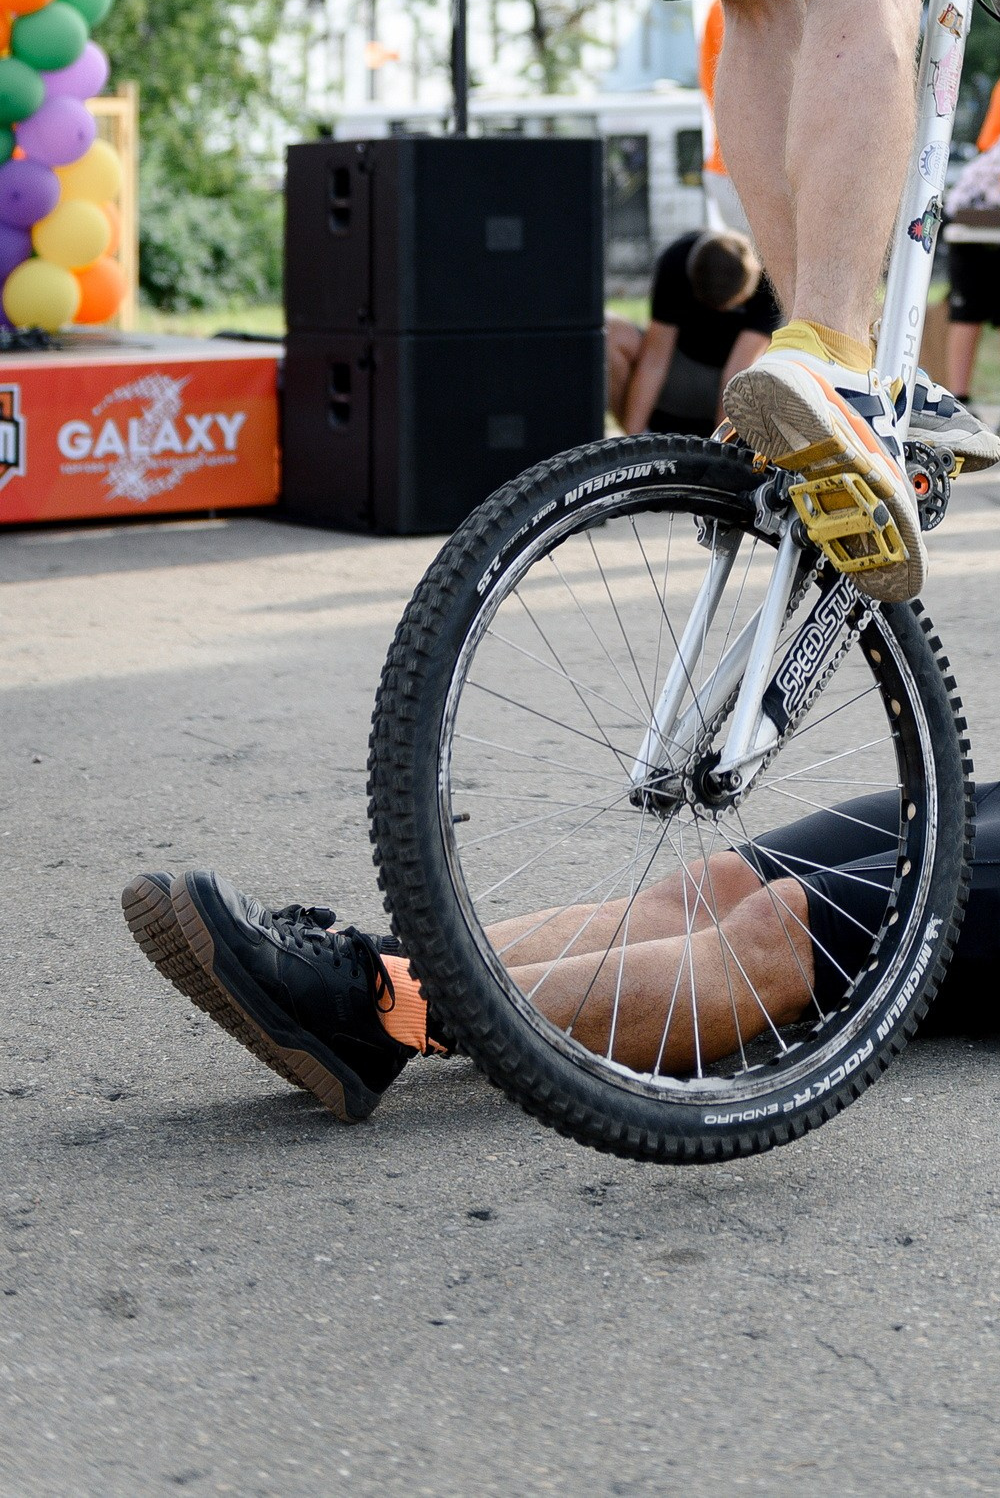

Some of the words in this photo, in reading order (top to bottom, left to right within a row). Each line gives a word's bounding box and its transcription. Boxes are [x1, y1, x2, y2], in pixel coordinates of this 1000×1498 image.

[57, 411, 247, 461] GALAXY
[564, 463, 653, 506] MICHELIN
[876, 943, 933, 1042] MICHELIN
[704, 1103, 779, 1125] ENDURO
